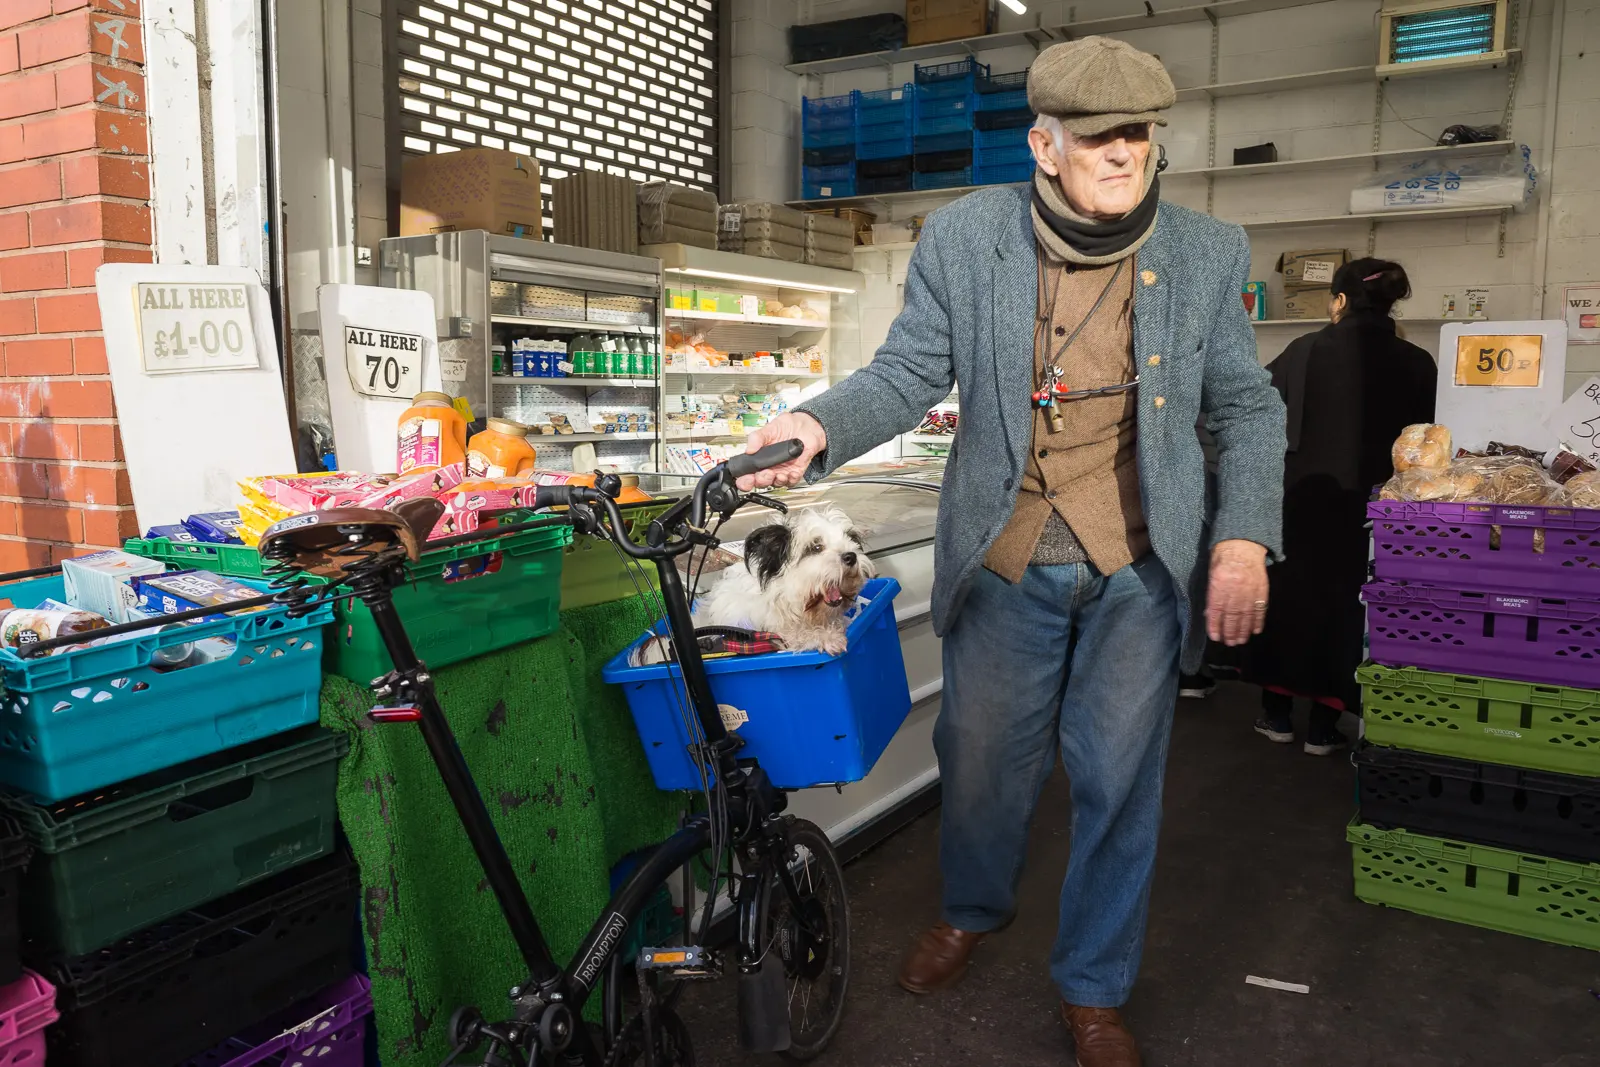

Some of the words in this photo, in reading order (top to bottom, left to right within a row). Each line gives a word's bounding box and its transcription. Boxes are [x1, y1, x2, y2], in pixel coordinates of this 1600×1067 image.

[143, 288, 183, 309] ALL
[188, 288, 245, 309] HERE
[1569, 299, 1592, 308] WE
[348, 330, 376, 347] ALL
[380, 334, 418, 352] HERE
[166, 582, 206, 595] BARS
[581, 919, 625, 983] BROMPTON
